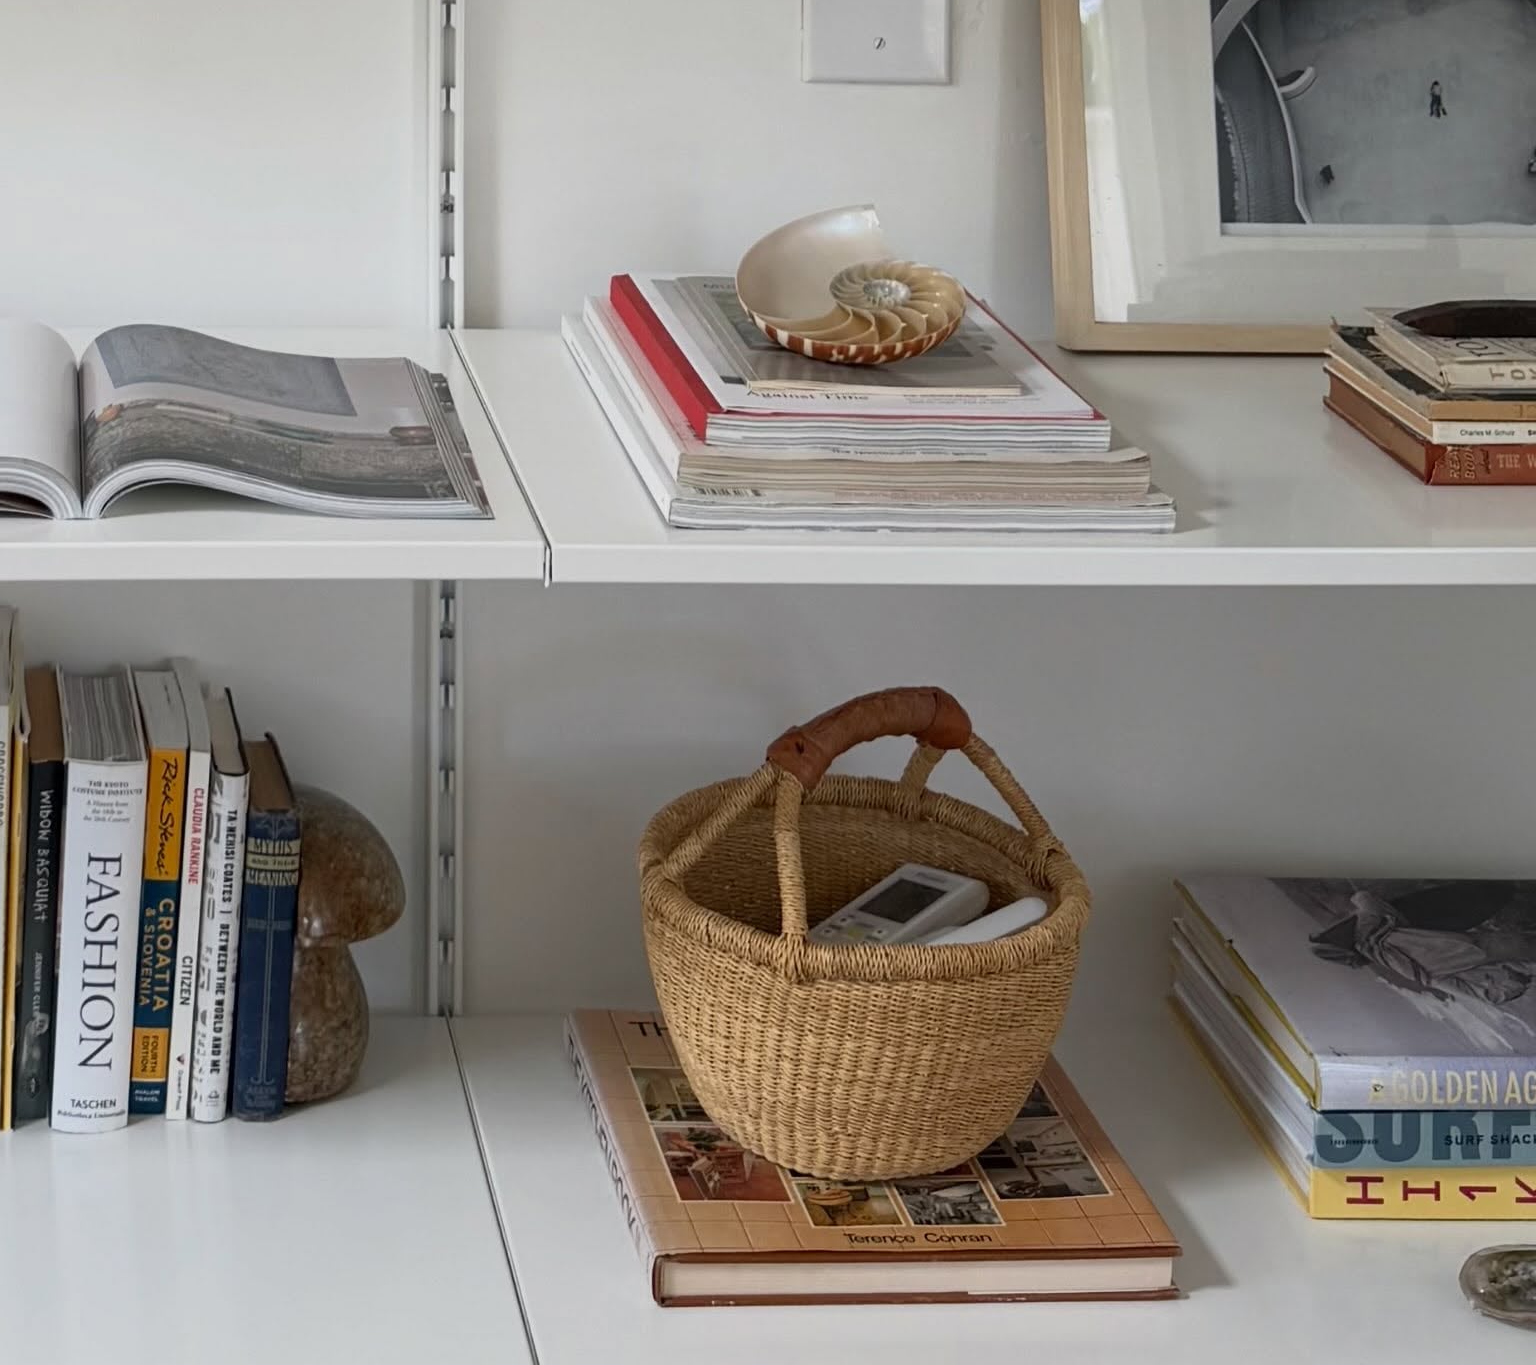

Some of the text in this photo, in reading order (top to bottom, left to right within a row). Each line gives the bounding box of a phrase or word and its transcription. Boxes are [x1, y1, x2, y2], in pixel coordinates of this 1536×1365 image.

[188, 788, 204, 884] CLAUDIA RANKINE
[78, 853, 123, 1069] FASHION
[140, 908, 155, 1006] & SLOVENIA
[152, 899, 176, 1011] CROATIA
[179, 956, 193, 1005] CITIZEN
[141, 1035, 151, 1071] EDITION
[150, 1035, 160, 1072] FOURTH
[71, 1099, 116, 1109] TASCHEN
[1392, 1070, 1497, 1105] GOLDEN
[844, 1233, 992, 1245] Terence Conran
